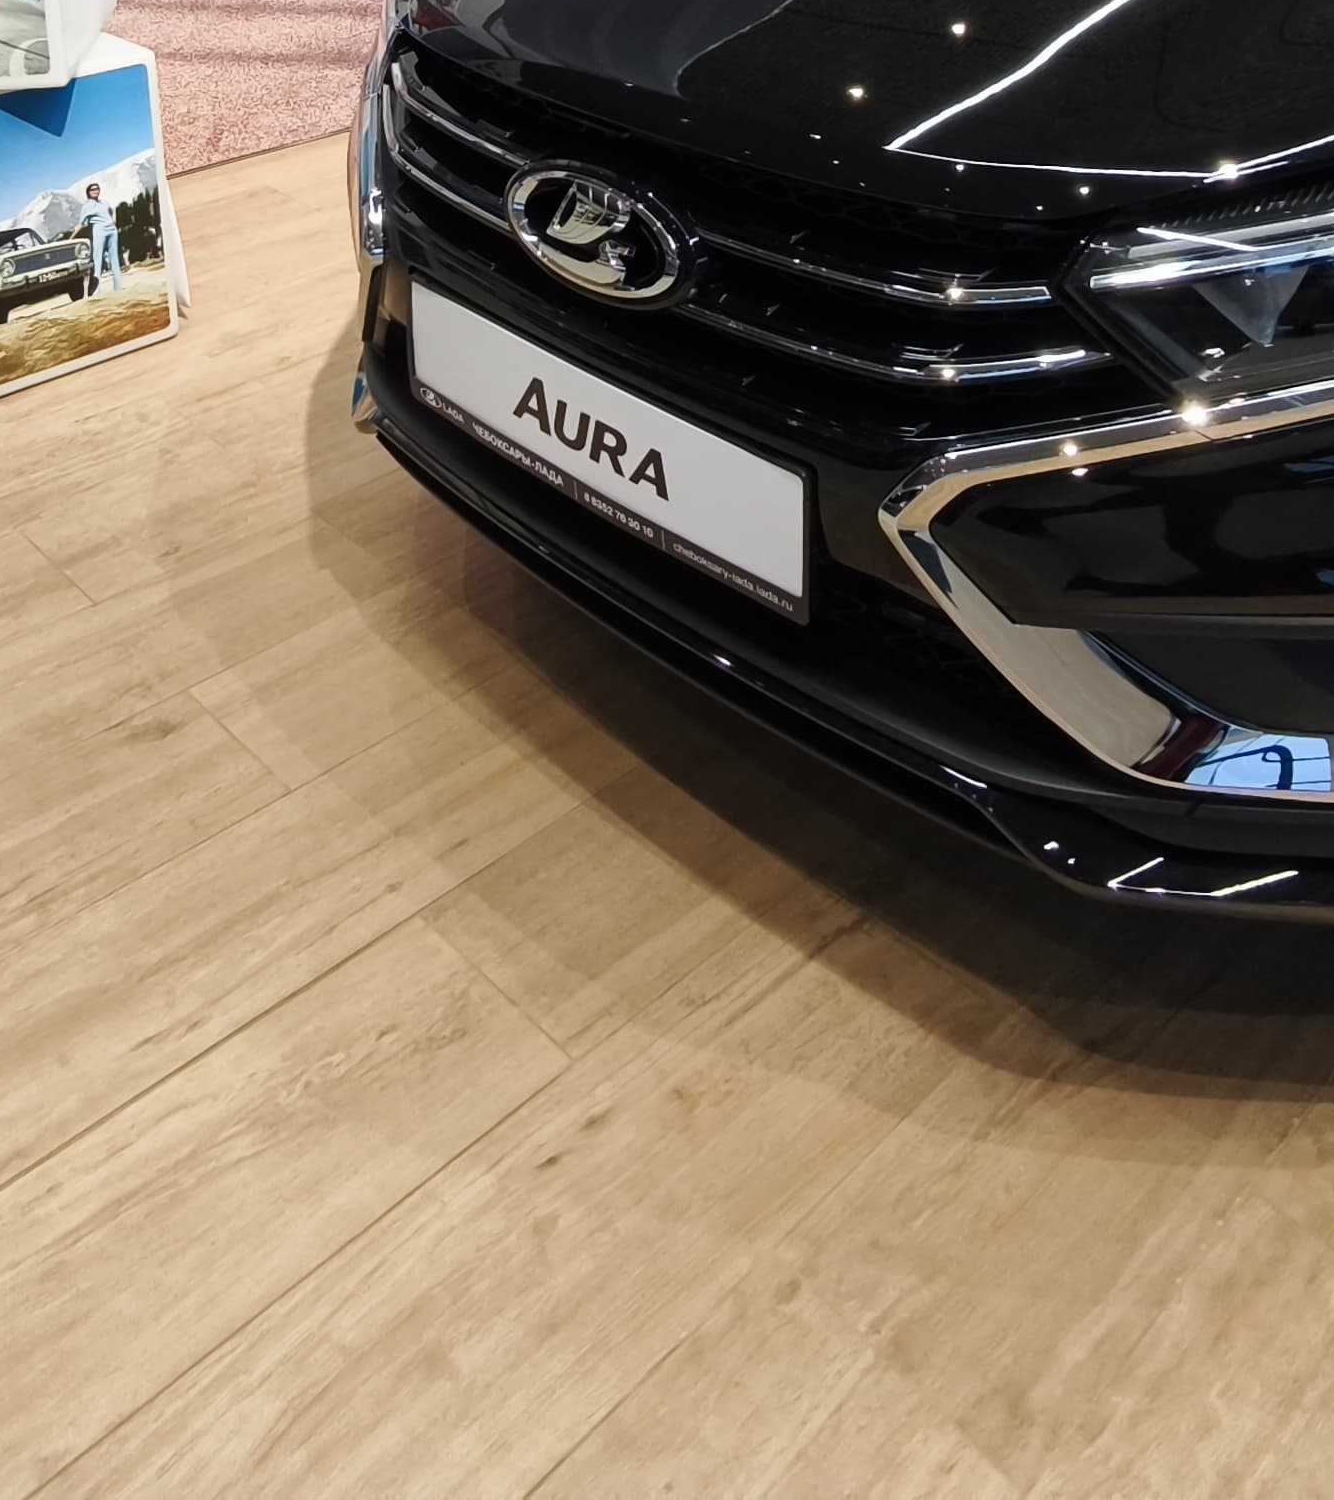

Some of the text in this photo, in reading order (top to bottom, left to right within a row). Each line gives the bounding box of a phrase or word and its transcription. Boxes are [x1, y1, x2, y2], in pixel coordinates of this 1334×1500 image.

[441, 402, 466, 424] LADA
[513, 376, 670, 502] AURA
[472, 421, 565, 487] ЧЕБОКСАРЫ-ЛАДА
